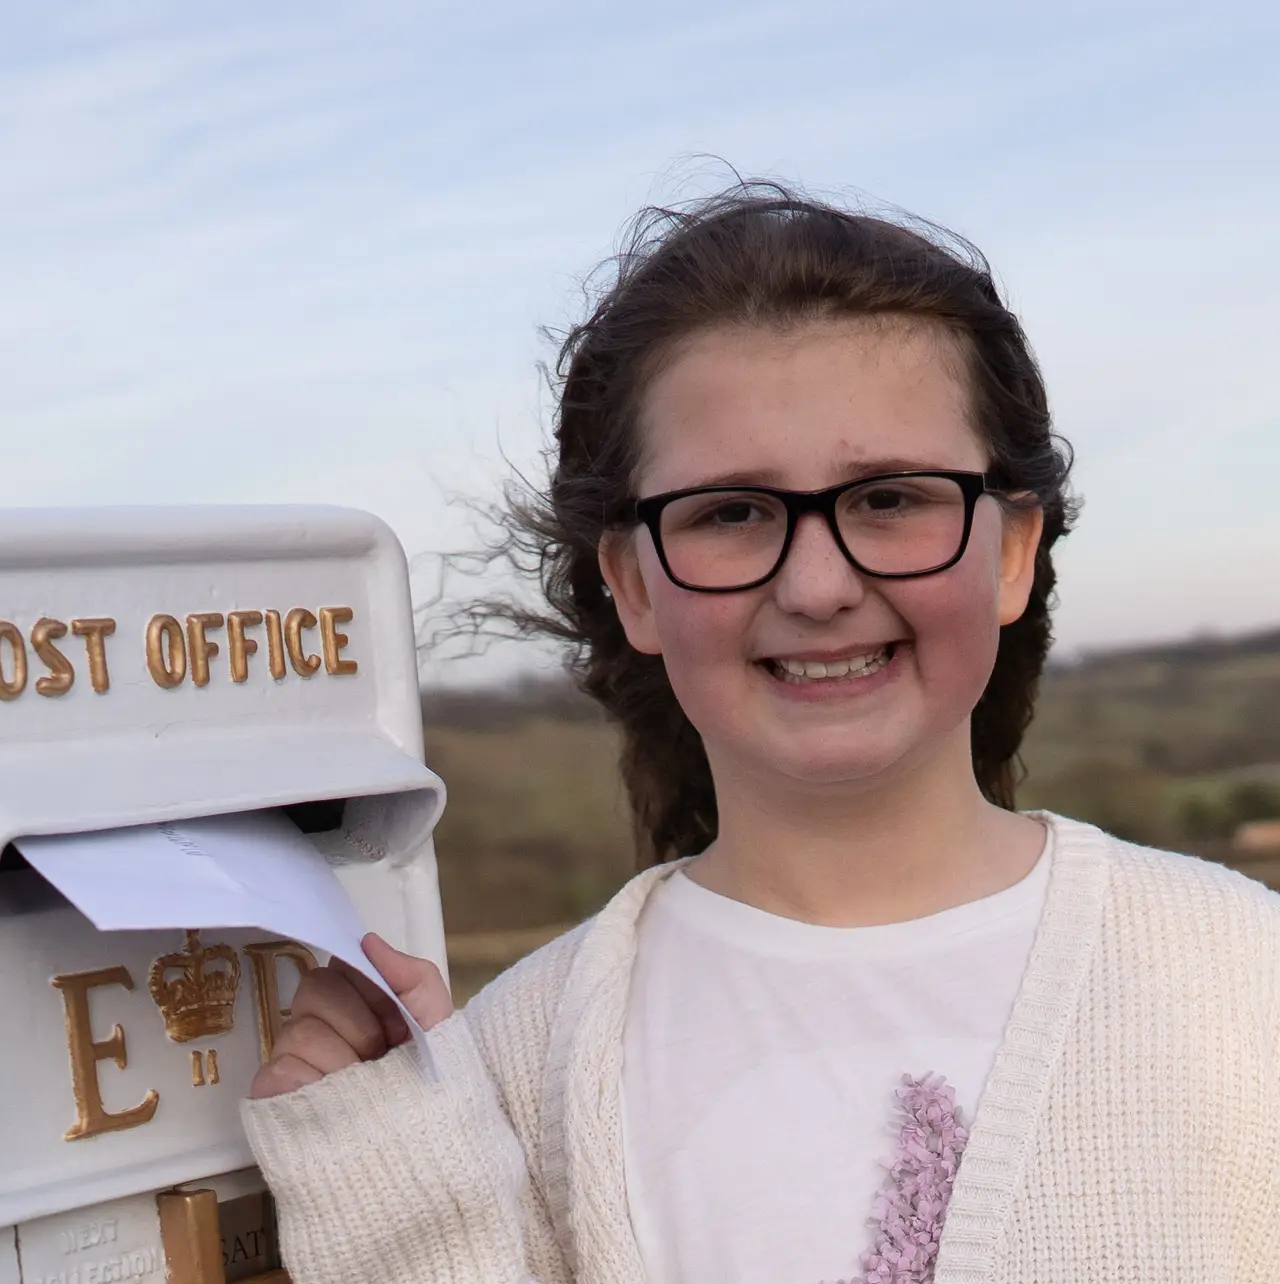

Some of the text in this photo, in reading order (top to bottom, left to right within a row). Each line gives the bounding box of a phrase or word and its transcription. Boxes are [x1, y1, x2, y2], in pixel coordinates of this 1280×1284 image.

[145, 606, 359, 689] OFFICE
[50, 965, 159, 1142] E
[60, 1219, 119, 1256] NEXT
